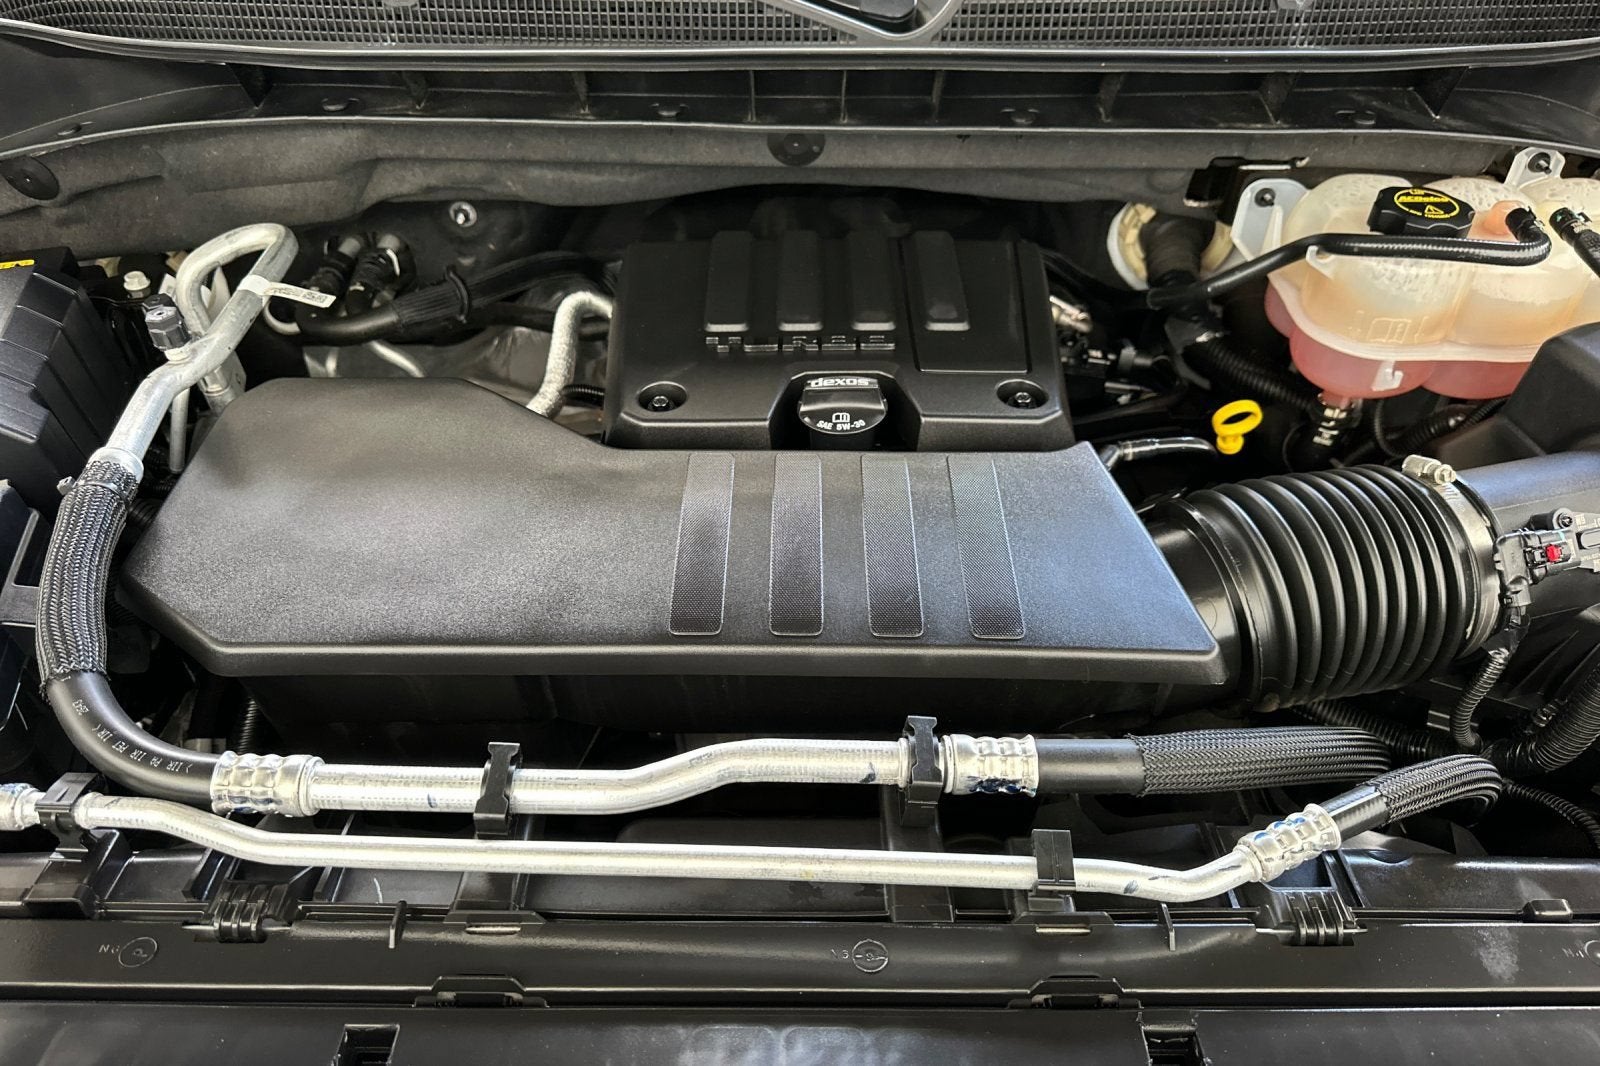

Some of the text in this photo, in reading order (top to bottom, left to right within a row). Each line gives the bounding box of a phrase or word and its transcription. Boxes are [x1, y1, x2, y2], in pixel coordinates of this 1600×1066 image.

[810, 378, 870, 387] dexos
[816, 419, 866, 430] SAE 5W-30
